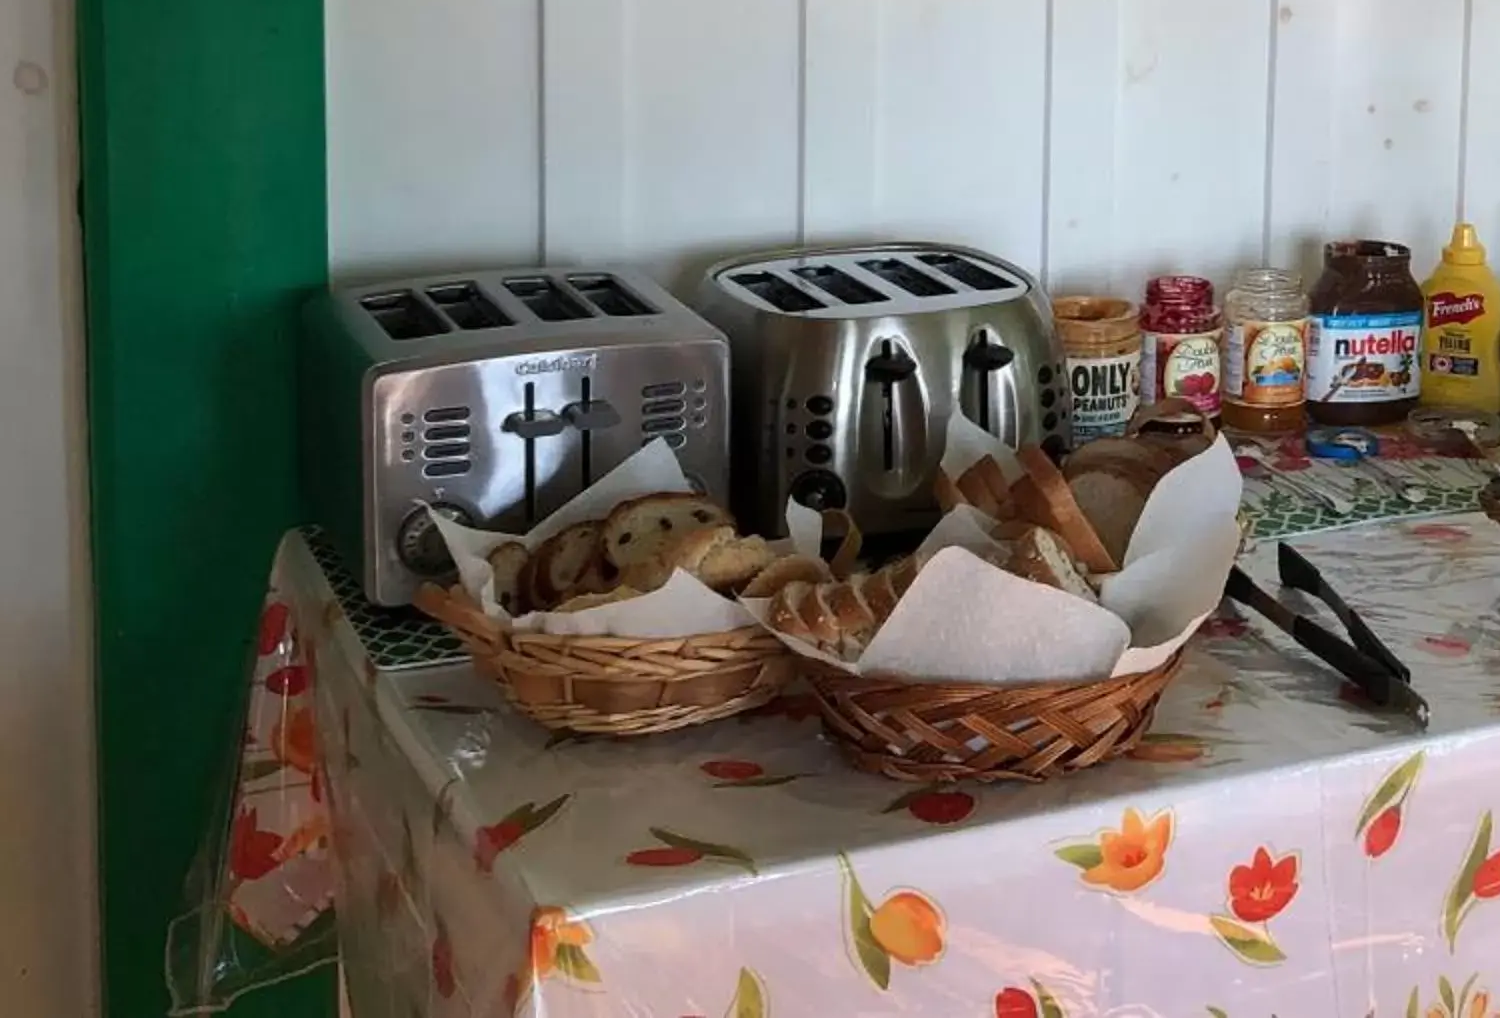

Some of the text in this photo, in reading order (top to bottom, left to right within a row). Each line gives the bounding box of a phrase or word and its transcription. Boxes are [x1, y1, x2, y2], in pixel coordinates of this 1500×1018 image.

[1433, 297, 1481, 317] French's
[1335, 329, 1415, 356] nutella
[1071, 361, 1130, 397] ONLY
[1073, 393, 1127, 413] PEANUTS
